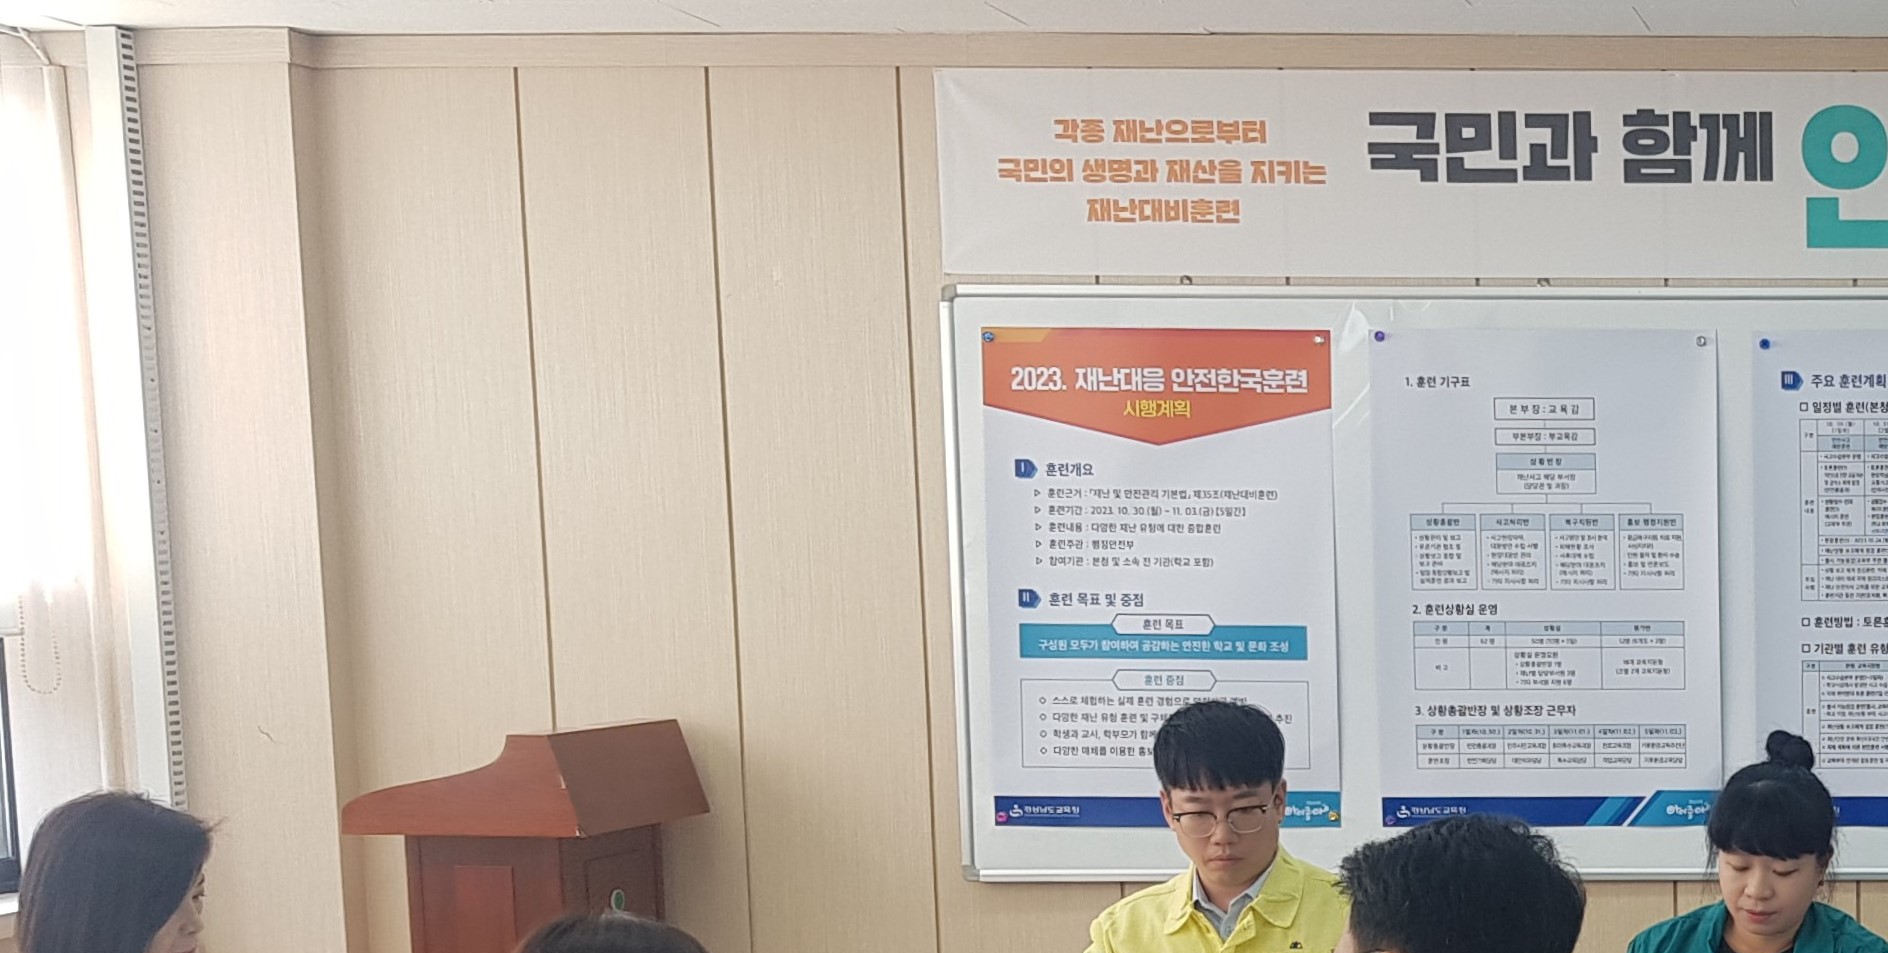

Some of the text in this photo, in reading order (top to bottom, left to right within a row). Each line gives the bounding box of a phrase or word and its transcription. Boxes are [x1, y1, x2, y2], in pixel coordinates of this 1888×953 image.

[1054, 119, 1266, 144] 각종 재난으로부터
[1368, 109, 1773, 183] 국민과 함께
[998, 158, 1327, 184] 국민의 생명과 재산을 지키는
[1087, 198, 1240, 223] 재난대비훈련
[1012, 366, 1307, 394] 2023. 재난대응 안전한국훈련
[1405, 376, 1470, 388] 1. 훈련 기구표
[1811, 375, 1835, 388] 주요
[1839, 374, 1886, 388] 훈련계획
[1123, 400, 1191, 418] 시행계획
[1812, 401, 1841, 413] 일정별
[1046, 463, 1094, 477] 훈련개요
[1049, 593, 1143, 607] 훈련 목표 및 중점
[1413, 604, 1497, 615] 2. 훈련상황실 운영
[1143, 619, 1184, 630] 훈련 목표
[1814, 616, 1853, 628] 훈련방법
[1070, 640, 1098, 652] 모두가
[1214, 641, 1232, 652] 학교
[1270, 641, 1289, 652] 조성
[1814, 643, 1888, 654] 기관별 훈련 유형
[1145, 675, 1184, 686] 훈련 중점
[1415, 705, 1576, 717] 3. 상황총괄반장 및 상황조장 근무자
[1120, 713, 1137, 723] 훈련
